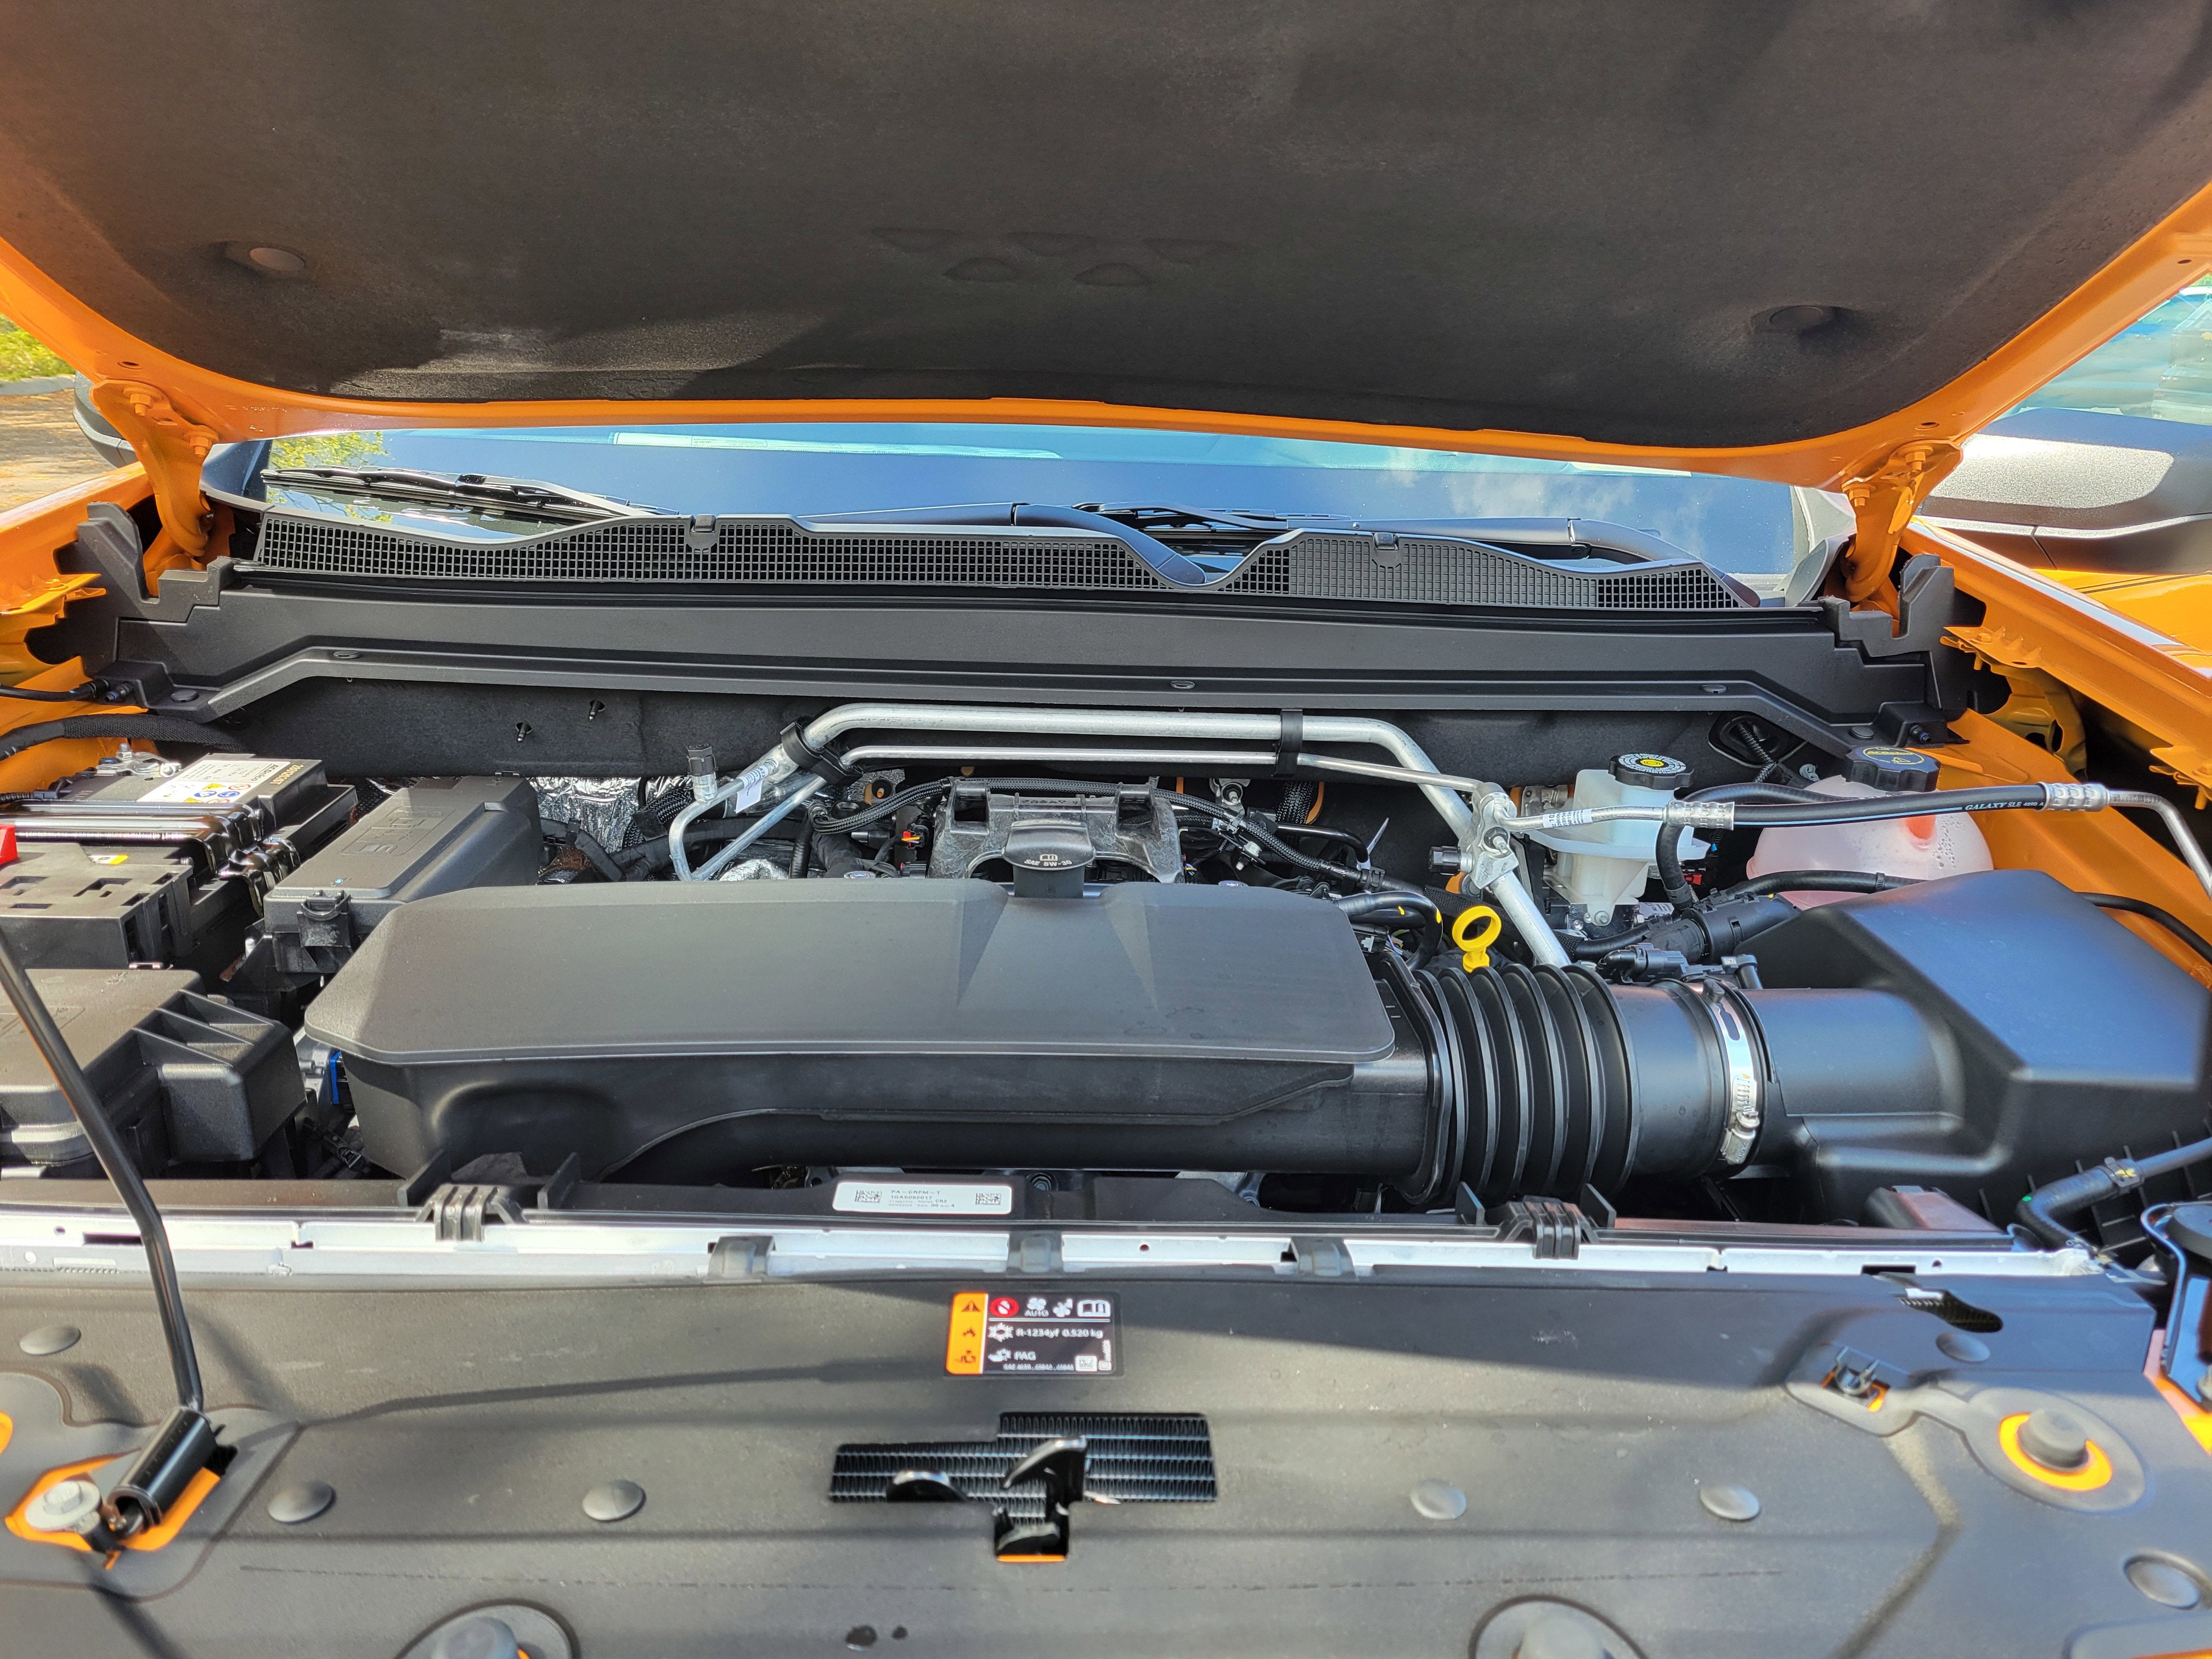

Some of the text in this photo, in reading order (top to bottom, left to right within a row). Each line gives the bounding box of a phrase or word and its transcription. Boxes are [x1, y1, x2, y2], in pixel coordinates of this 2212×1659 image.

[251, 764, 279, 781] ACDelco
[1965, 802, 2008, 810] GALAXY
[1015, 1328, 1060, 1339] R-1234yf
[1090, 1328, 1103, 1339] kg
[1014, 1351, 1036, 1361] PAG
